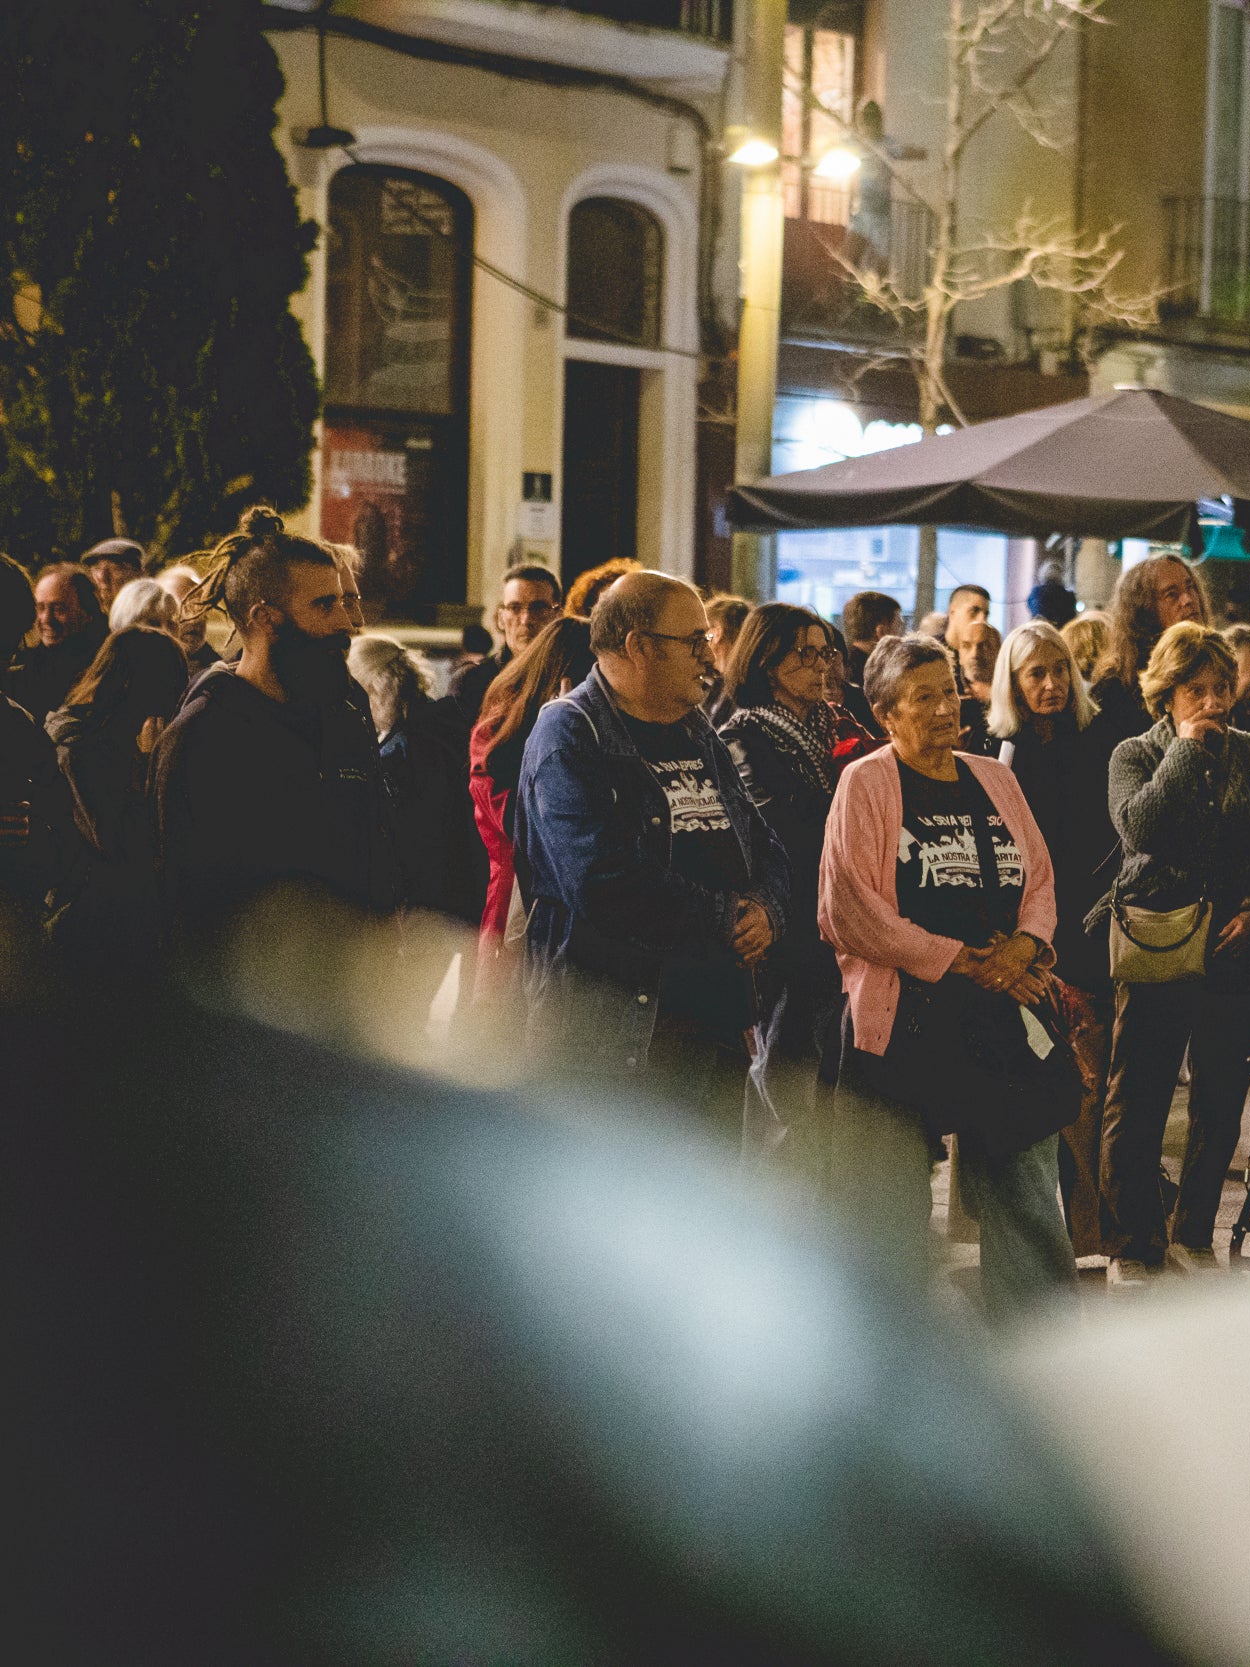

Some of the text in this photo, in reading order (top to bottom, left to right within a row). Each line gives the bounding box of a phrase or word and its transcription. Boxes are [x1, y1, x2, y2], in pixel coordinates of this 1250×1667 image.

[918, 816, 936, 827] LA
[932, 814, 958, 827] SEVA
[926, 853, 940, 864] LA
[941, 851, 971, 862] NOSTRA
